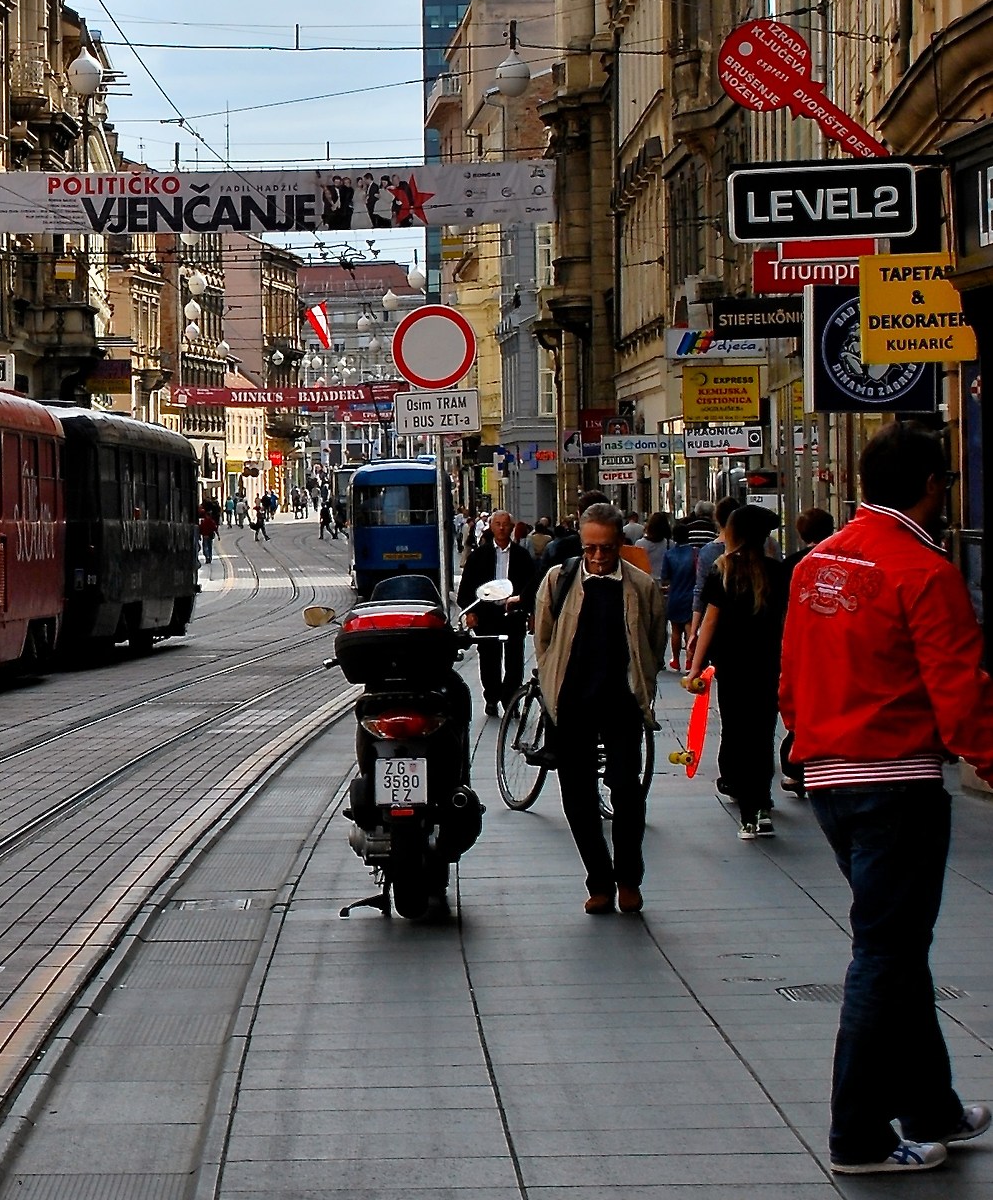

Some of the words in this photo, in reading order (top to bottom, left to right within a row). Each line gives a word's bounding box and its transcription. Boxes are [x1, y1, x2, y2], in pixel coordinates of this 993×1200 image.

[768, 23, 807, 60] IZRADA
[757, 58, 790, 82] express
[721, 71, 763, 110] NOŽEVA
[47, 171, 180, 195] POLITIČKO
[81, 183, 317, 234] VJENČANJE
[747, 185, 899, 224] LEVEL2
[911, 289, 925, 305] &
[886, 336, 953, 351] KUHARIĆ
[832, 363, 874, 396] DINAMO
[230, 390, 283, 403] MINKUS
[298, 389, 365, 404] BAJADERA
[406, 398, 432, 411] Osim
[436, 396, 467, 409] TRAM
[413, 415, 434, 428] BUS
[440, 414, 470, 426] ZET-a
[687, 427, 744, 437] PRAONICA
[604, 439, 623, 450] naš
[634, 440, 657, 449] dom
[687, 440, 731, 449] RUBLJA
[602, 472, 634, 481] CIPELE
[385, 761, 406, 774] ZG
[383, 775, 420, 788] 3580
[391, 788, 412, 802] EZ
